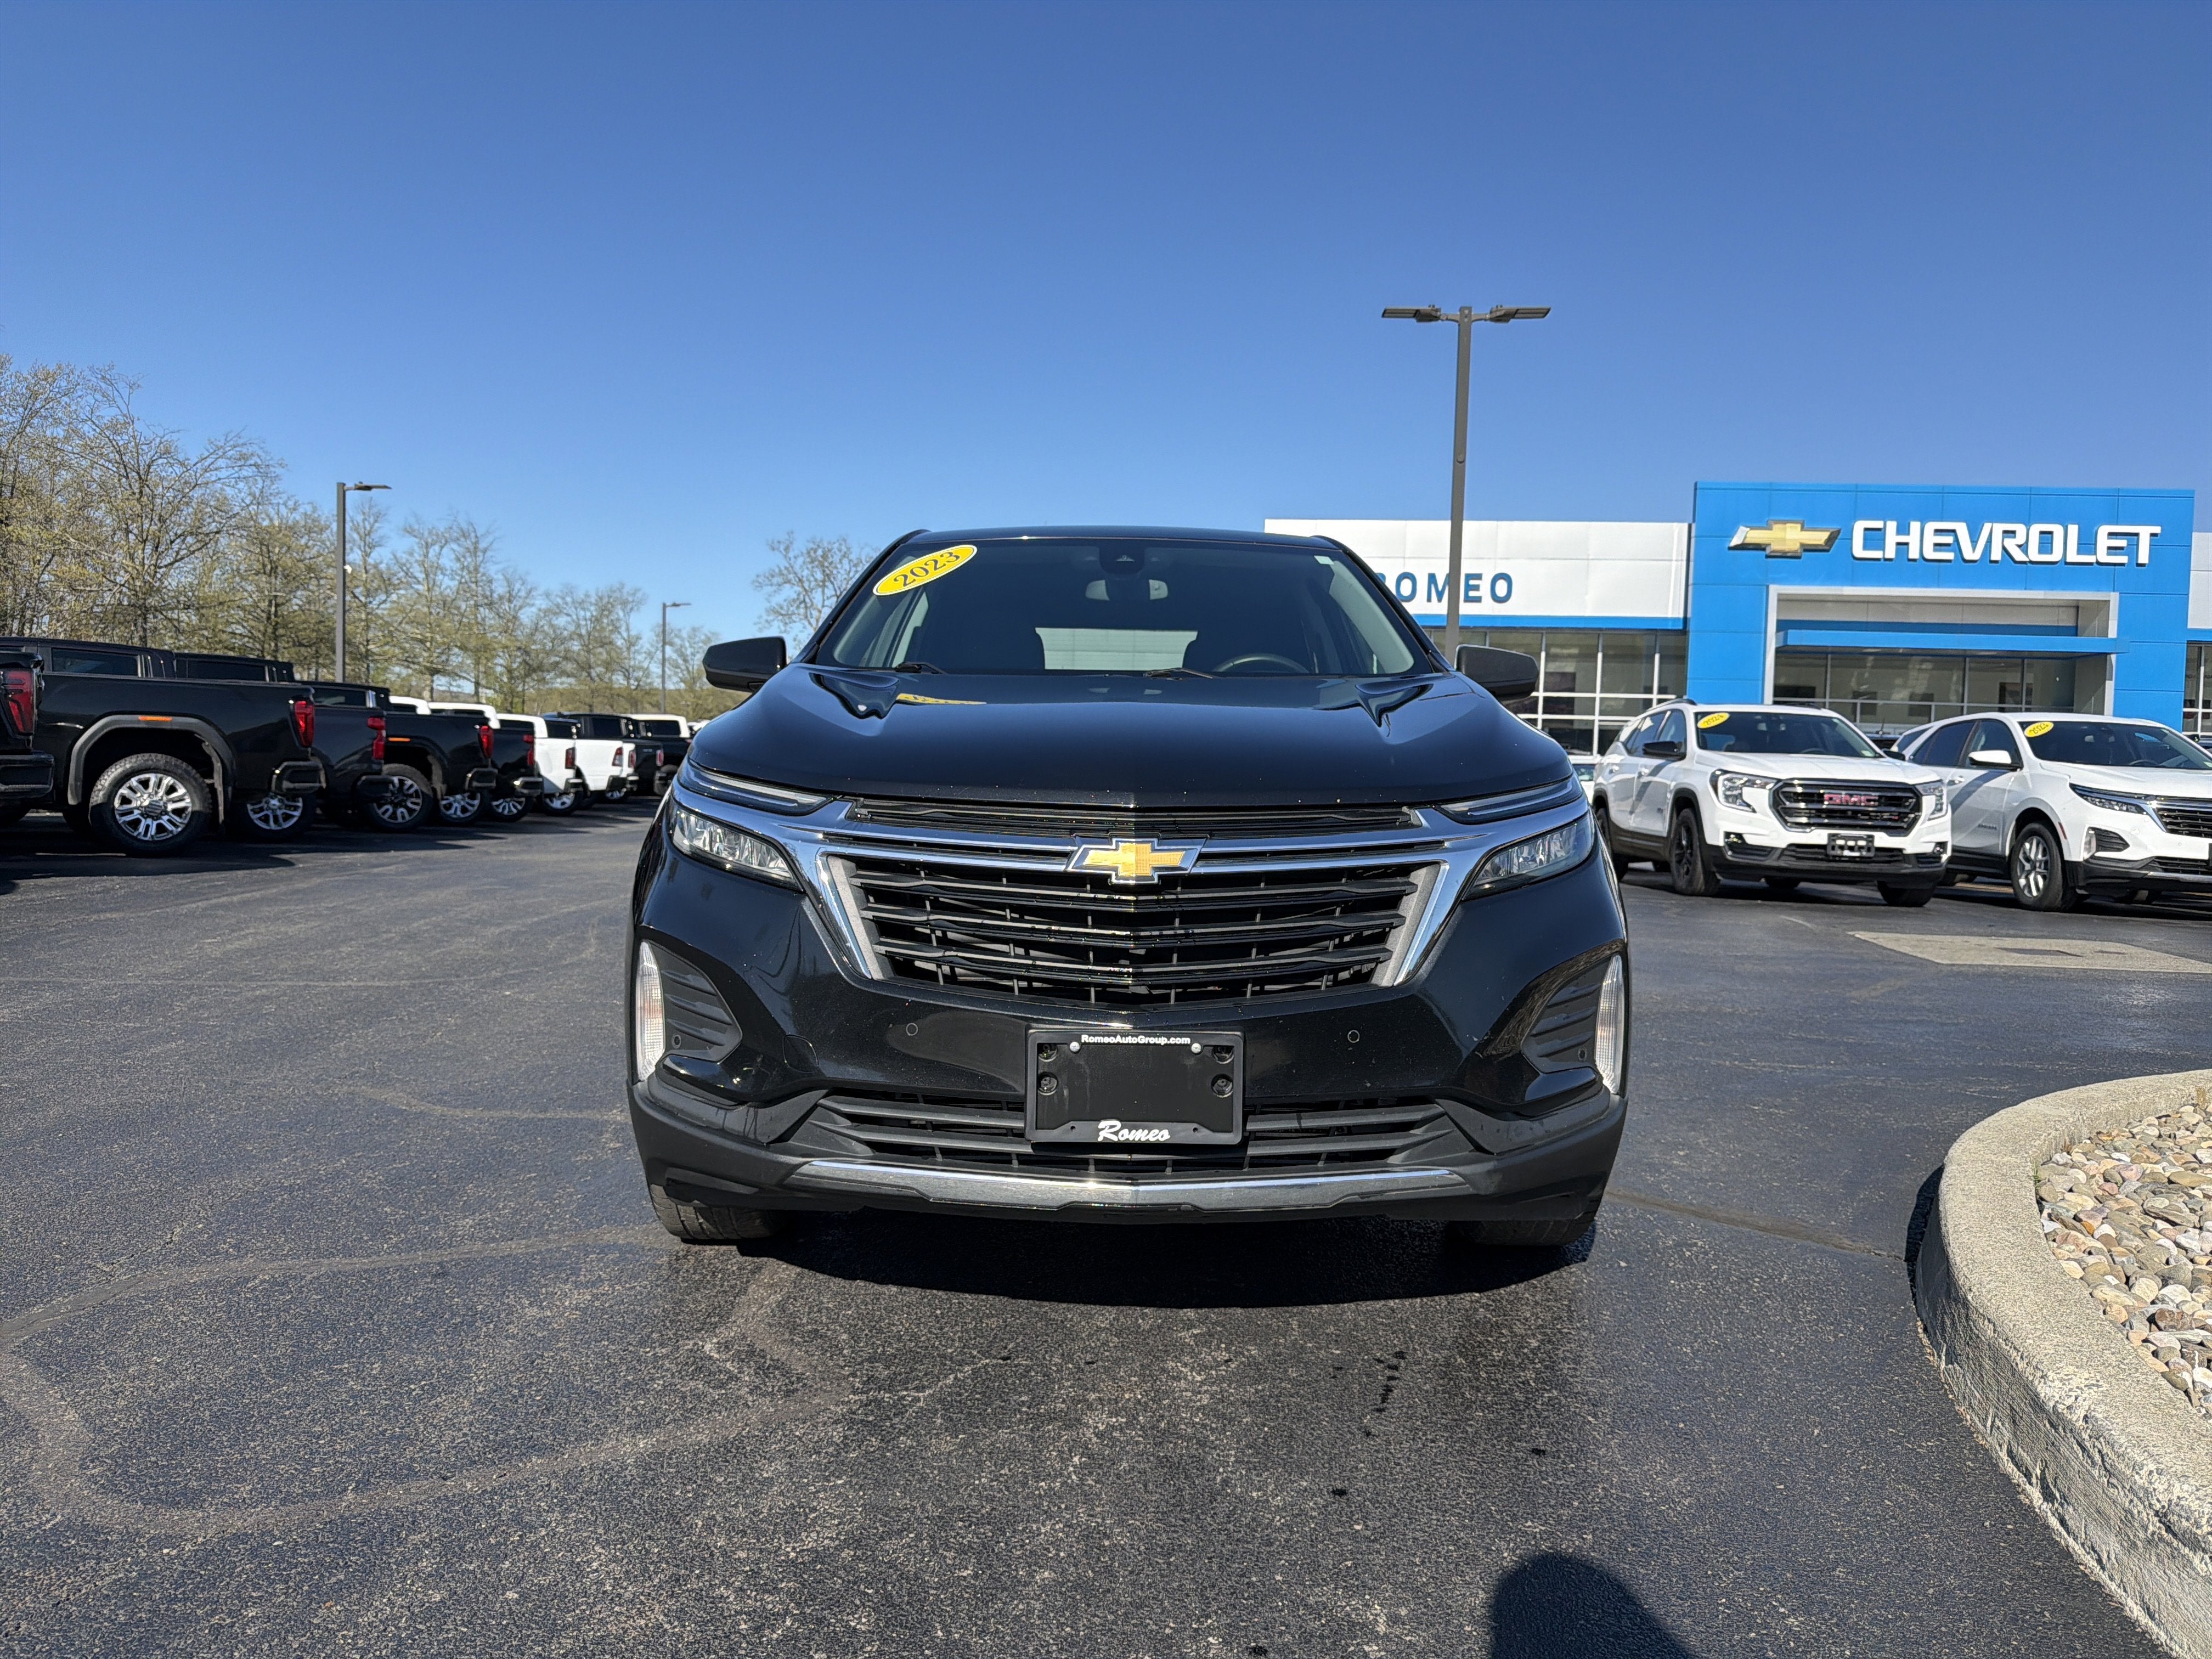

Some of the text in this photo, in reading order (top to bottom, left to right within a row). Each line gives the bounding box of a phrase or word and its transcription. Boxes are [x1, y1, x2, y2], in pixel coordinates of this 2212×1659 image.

[1852, 520, 2162, 566] CHEVROLET
[893, 552, 960, 588] 2023
[1376, 572, 1513, 603] OMEO
[1824, 794, 1878, 805] GMC
[1081, 1034, 1190, 1045] RomeoAutoGroup.com
[1097, 1120, 1171, 1142] Romeo
